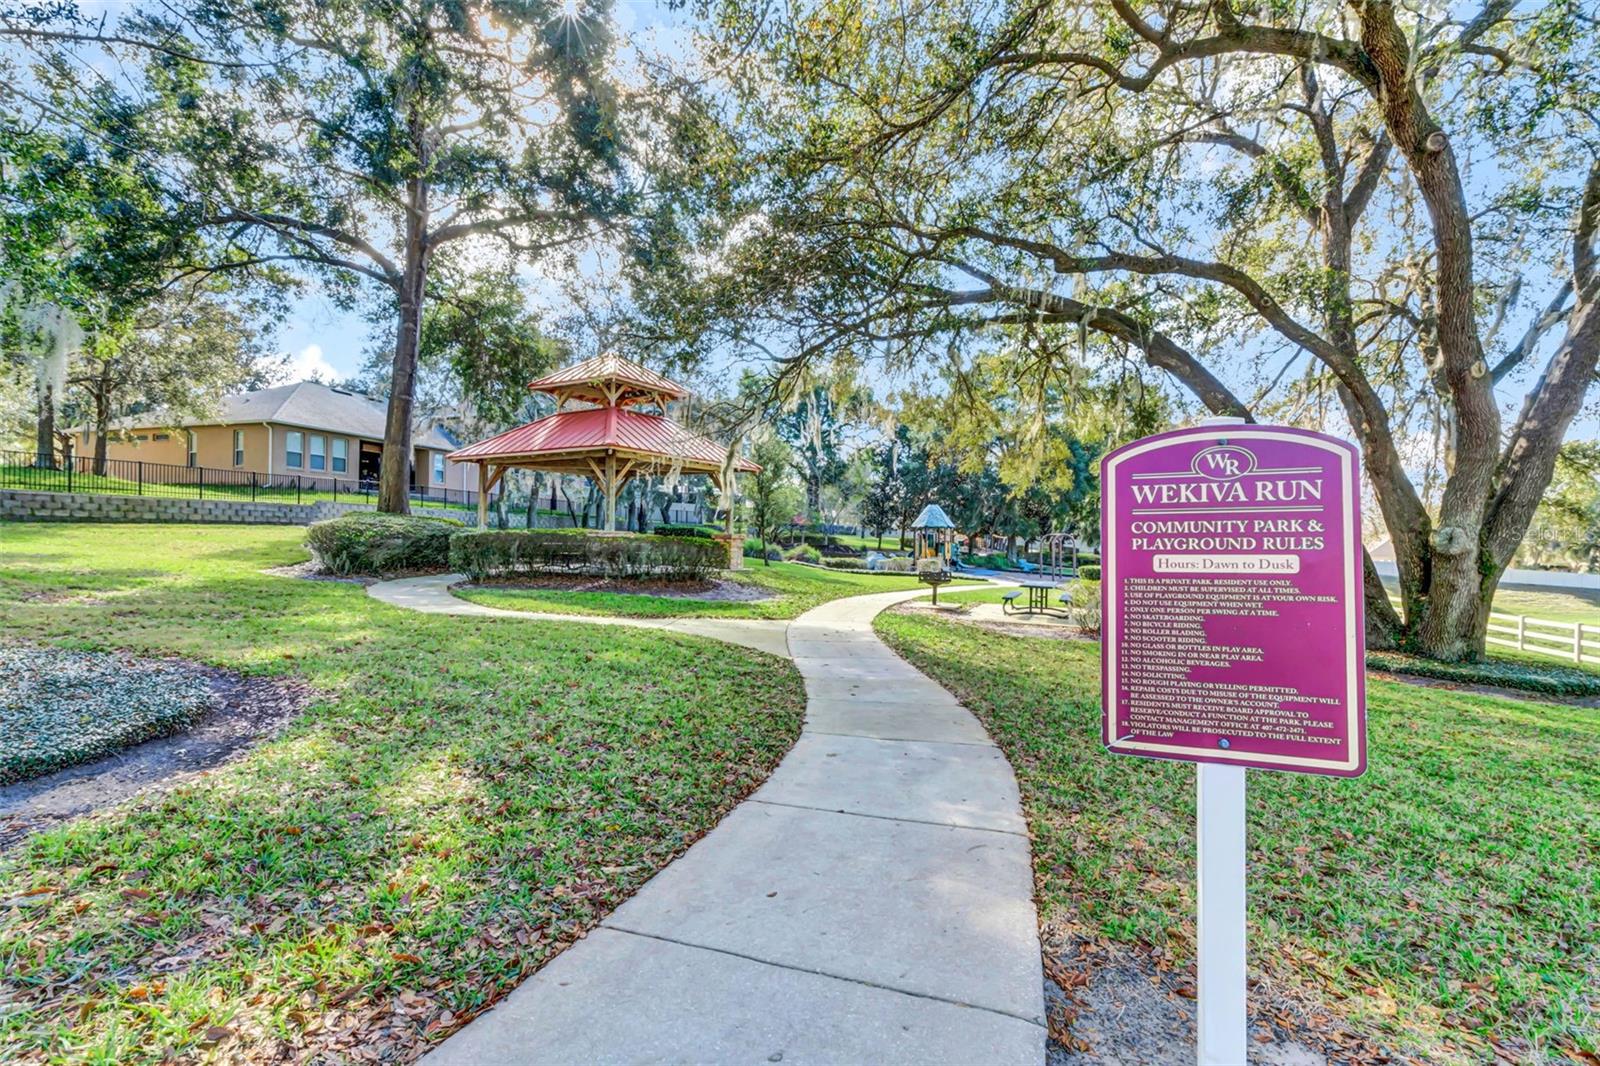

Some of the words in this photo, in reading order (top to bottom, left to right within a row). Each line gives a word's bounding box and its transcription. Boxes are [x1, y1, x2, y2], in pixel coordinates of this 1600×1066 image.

[1205, 453, 1241, 475] WR
[1130, 481, 1249, 504] WEKIVA
[1255, 479, 1323, 500] RUN
[1131, 519, 1249, 534] COMMUNITY
[1253, 519, 1304, 533] PARK
[1307, 518, 1325, 532] &
[1131, 537, 1257, 551] PLAYGROUND
[1262, 536, 1325, 550] RULES
[1158, 558, 1199, 570] Hours:
[1202, 558, 1239, 570] Dawn
[1242, 561, 1255, 570] to
[1259, 559, 1294, 570] Dusk
[1187, 659, 1231, 667] BEVERAGES.
[1241, 654, 1264, 662] AREA.
[1142, 664, 1192, 672] TRESPASSING.
[1142, 672, 1187, 680] SOLICITING.
[1215, 683, 1248, 691] YELLING
[1249, 685, 1298, 694] PERMITTED.
[1141, 693, 1175, 702] ASSESSED
[1240, 700, 1280, 709] ACCOUNT.
[1269, 694, 1319, 704] EQUIPMENT
[1131, 700, 1170, 708] RESIDENTS
[1193, 704, 1225, 712] RECEIVE
[1226, 706, 1253, 714] BOARD
[1254, 708, 1295, 718] APPROVAL
[1130, 714, 1164, 722] CONTACT
[1165, 717, 1219, 727] MANAGEMENT
[1221, 721, 1250, 729] OFFICE
[1208, 712, 1248, 722] FUNCTION
[1303, 720, 1334, 728] PLEASE
[1130, 721, 1171, 730] VIOLATORS
[1203, 727, 1254, 737] PROSECUTED
[1286, 733, 1307, 742] FULL
[1308, 735, 1341, 745] EXTENT
